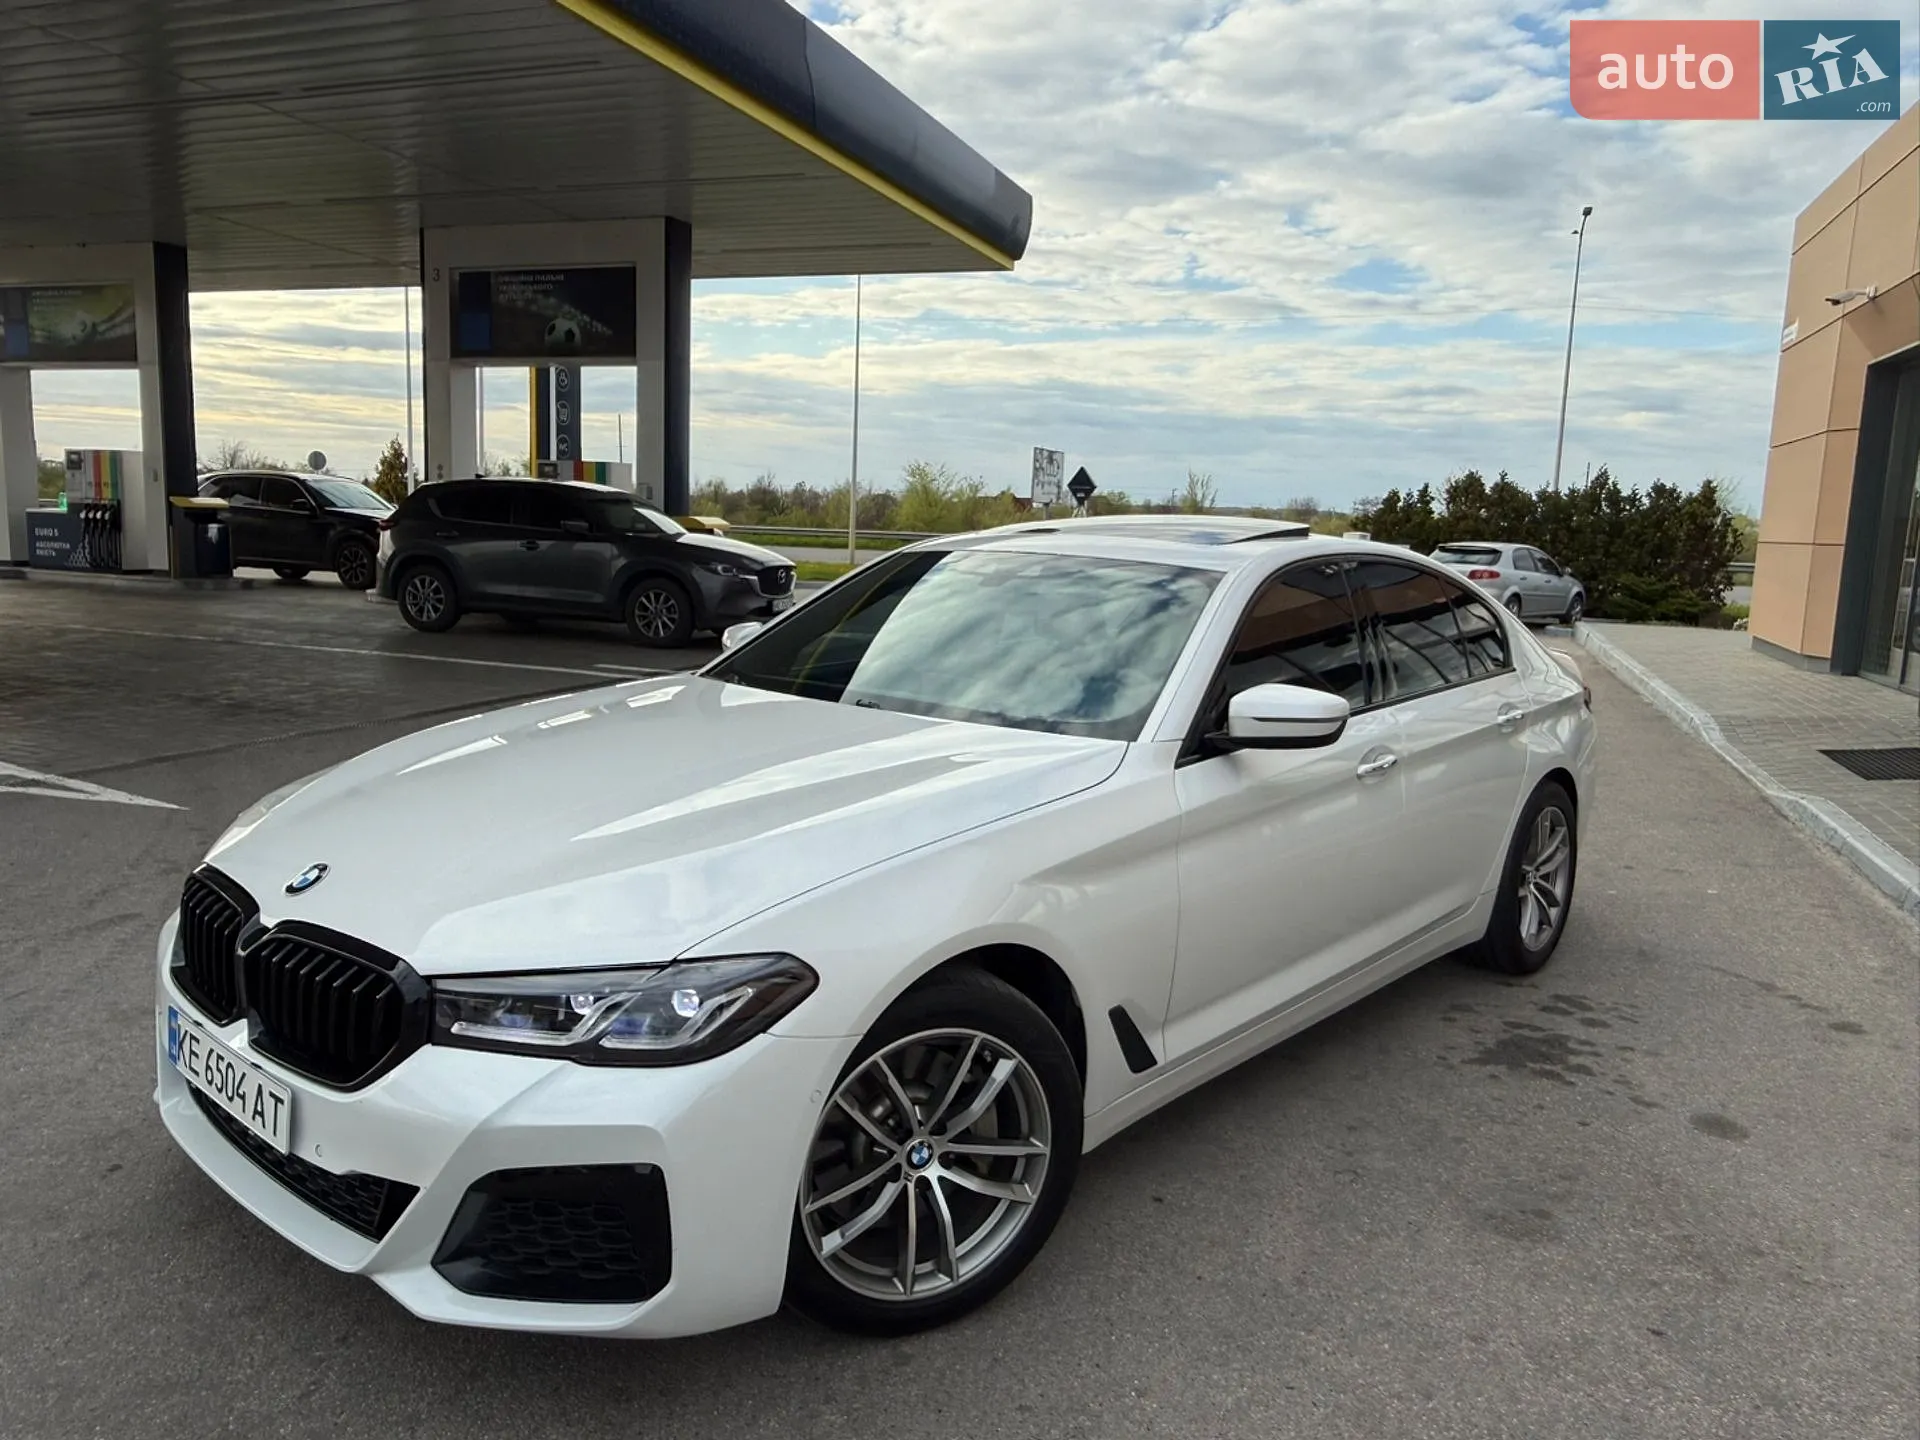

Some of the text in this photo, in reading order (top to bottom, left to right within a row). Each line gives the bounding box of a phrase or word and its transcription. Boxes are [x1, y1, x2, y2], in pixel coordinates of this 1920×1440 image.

[432, 267, 440, 282] 3
[177, 1023, 285, 1137] KE 6504 AT
